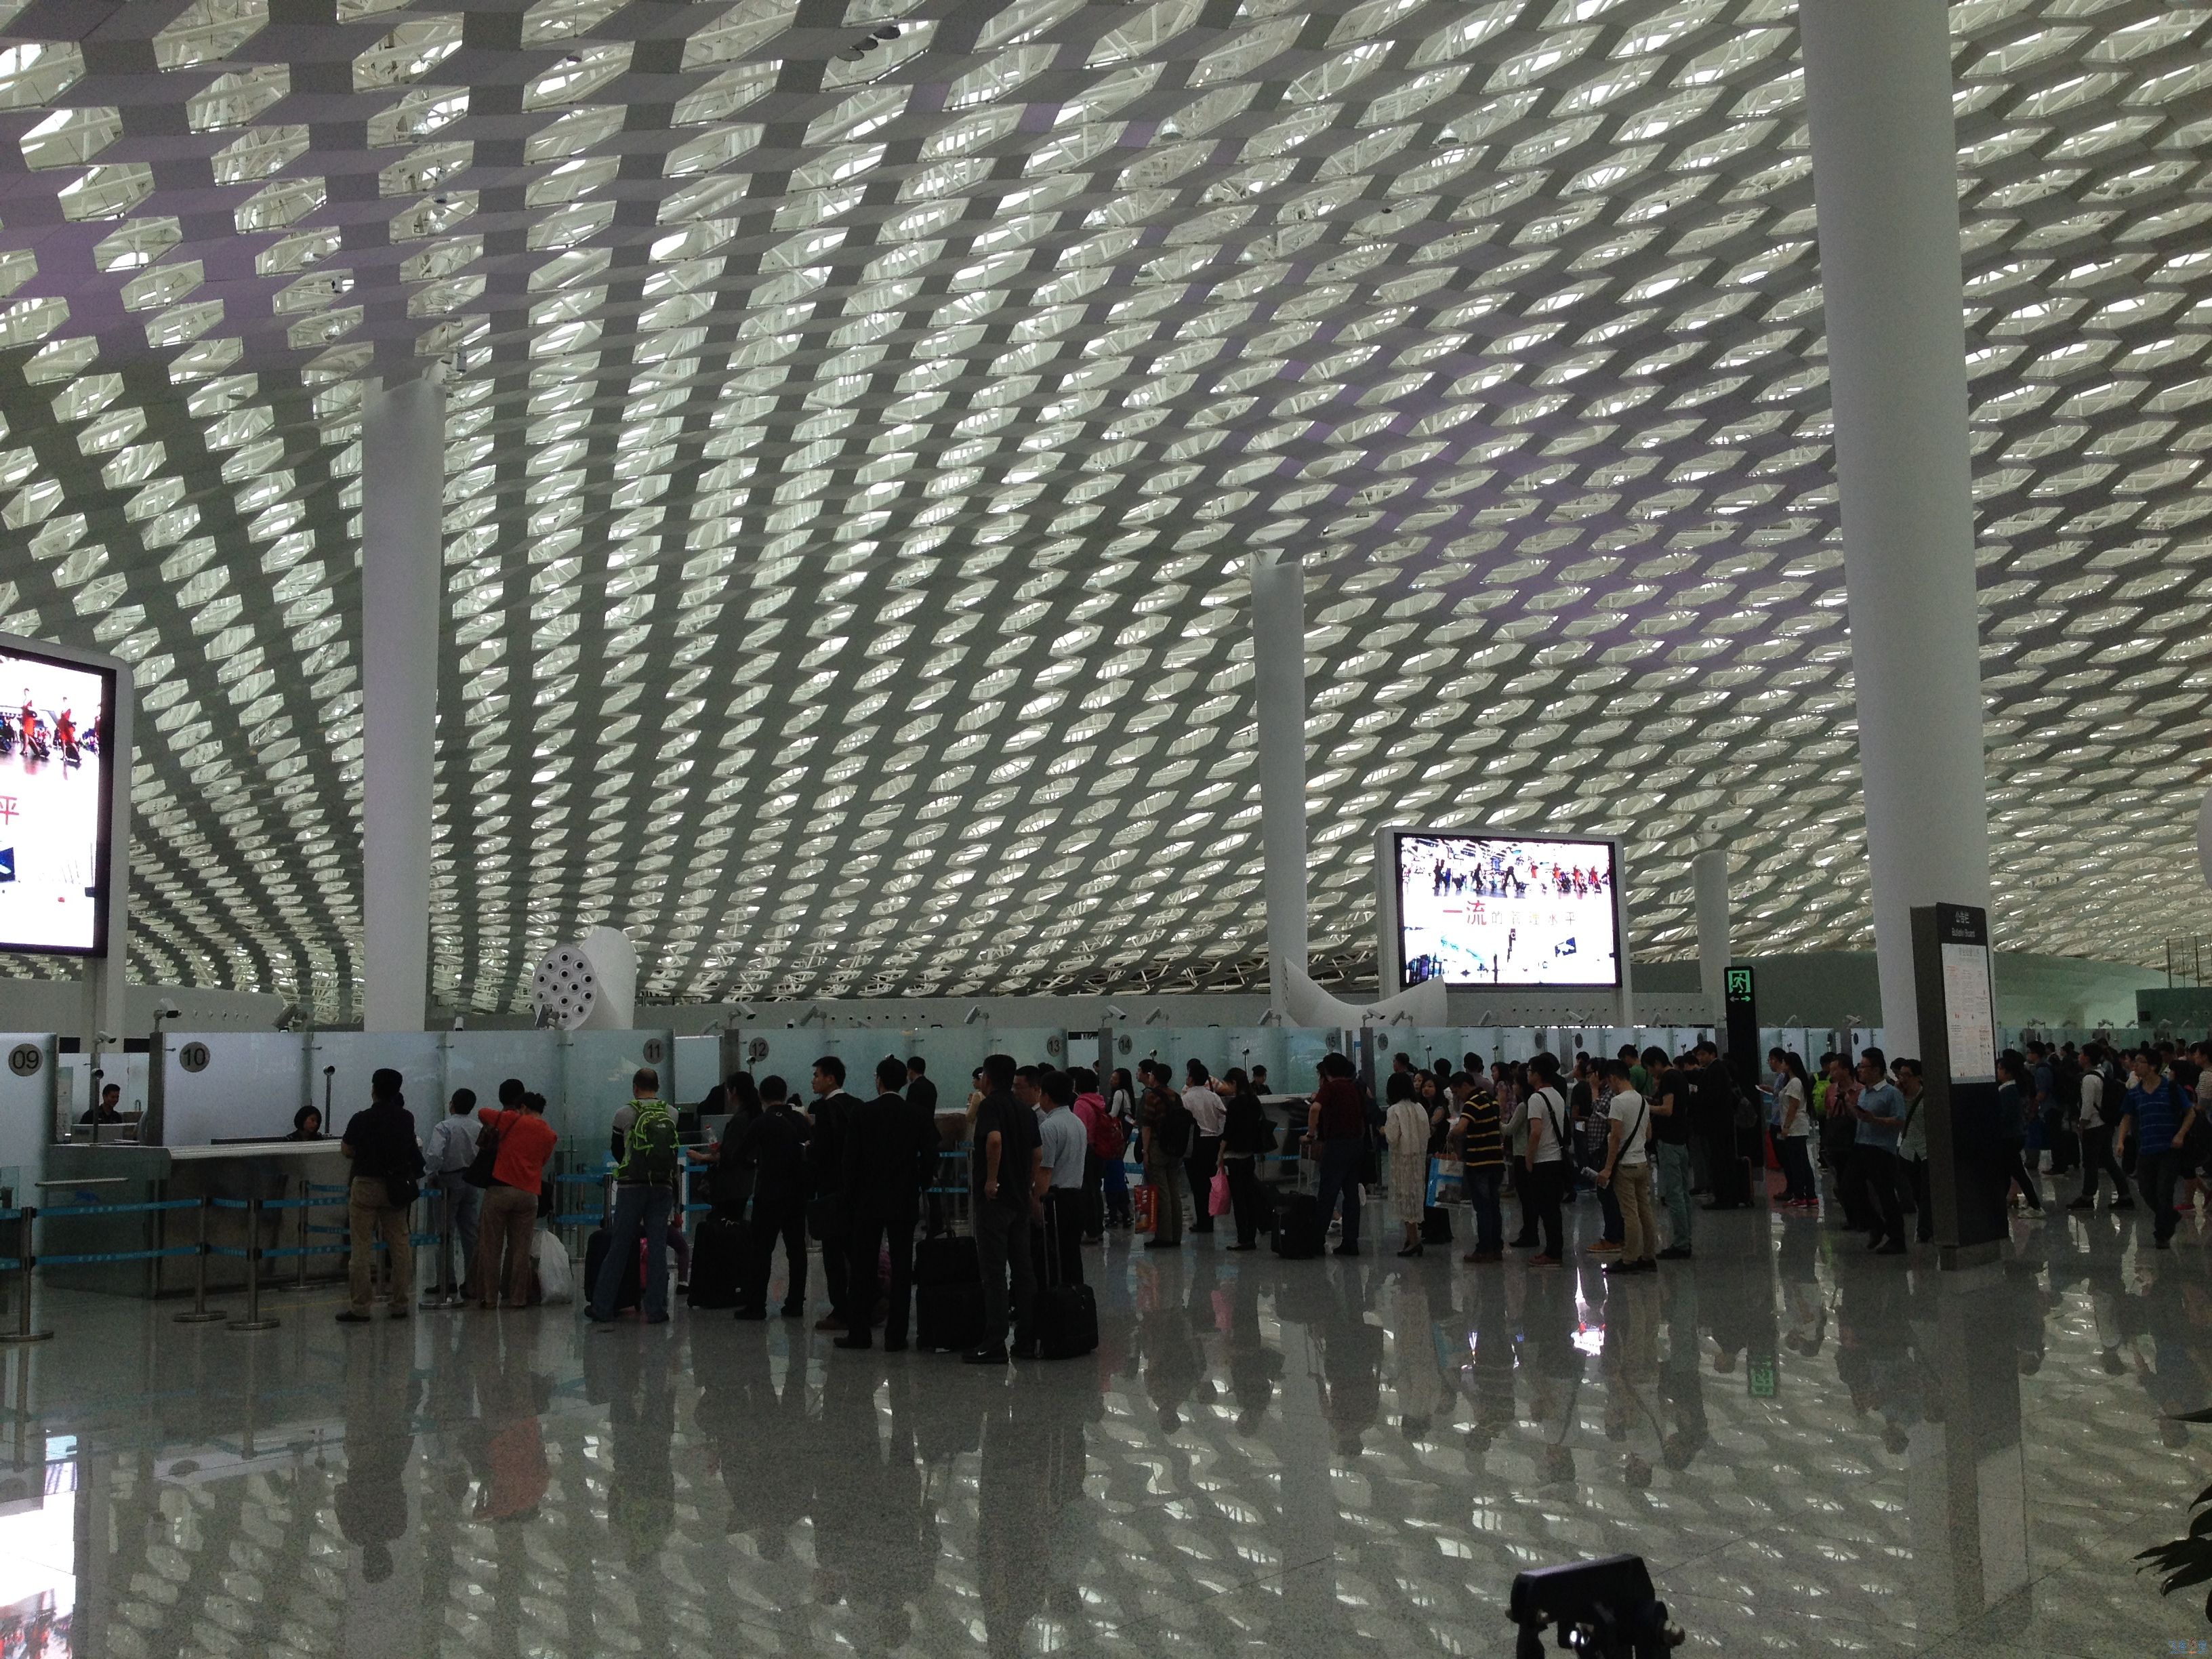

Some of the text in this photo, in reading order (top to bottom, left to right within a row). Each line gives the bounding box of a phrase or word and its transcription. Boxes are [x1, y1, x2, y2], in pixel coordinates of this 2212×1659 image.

[0, 796, 20, 825] 平
[1955, 912, 1970, 924] 公告栏
[1049, 1040, 1060, 1052] 13
[1120, 1038, 1131, 1050] 14
[1328, 1036, 1336, 1047] 15
[182, 1048, 206, 1066] 10
[648, 1044, 660, 1059] 11
[752, 1042, 766, 1057] 12
[13, 1050, 39, 1069] 09
